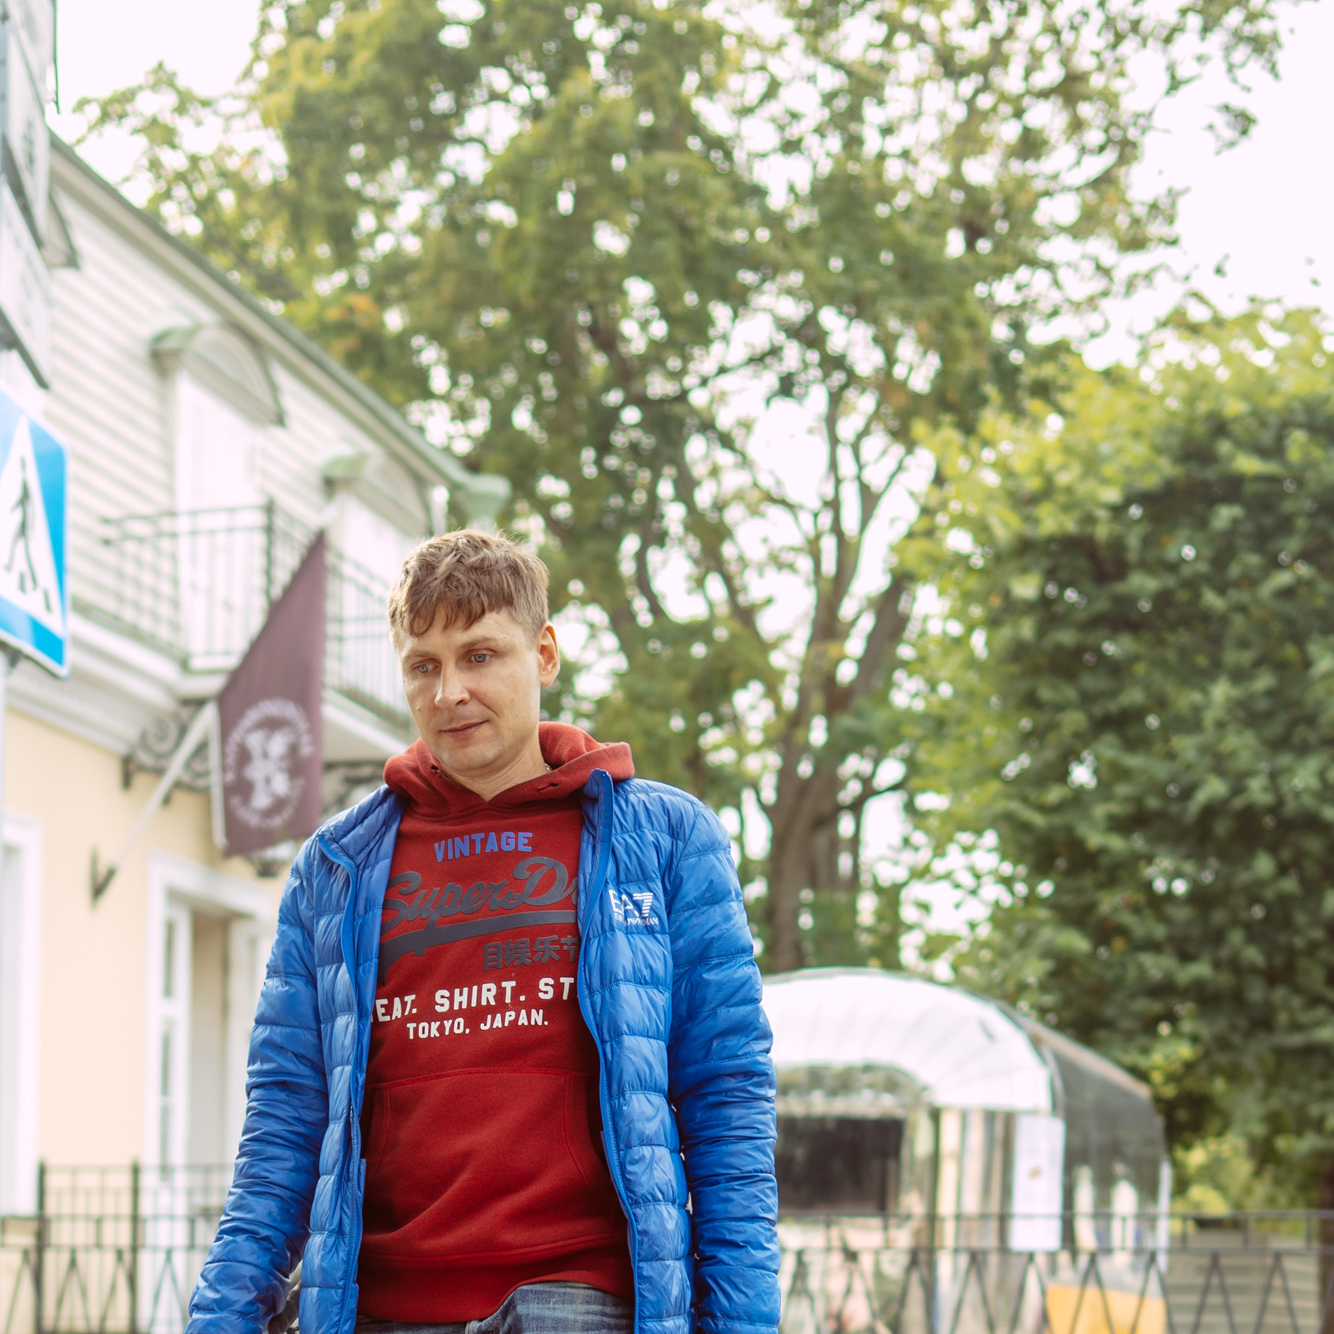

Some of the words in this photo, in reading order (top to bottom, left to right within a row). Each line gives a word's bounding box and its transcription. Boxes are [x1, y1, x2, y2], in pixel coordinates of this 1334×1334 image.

[434, 831, 533, 863] VINTAGE
[608, 889, 654, 918] EA7
[371, 994, 418, 1022] EAT.
[434, 980, 526, 1013] SHIRT.
[479, 1008, 549, 1031] JAPAN.
